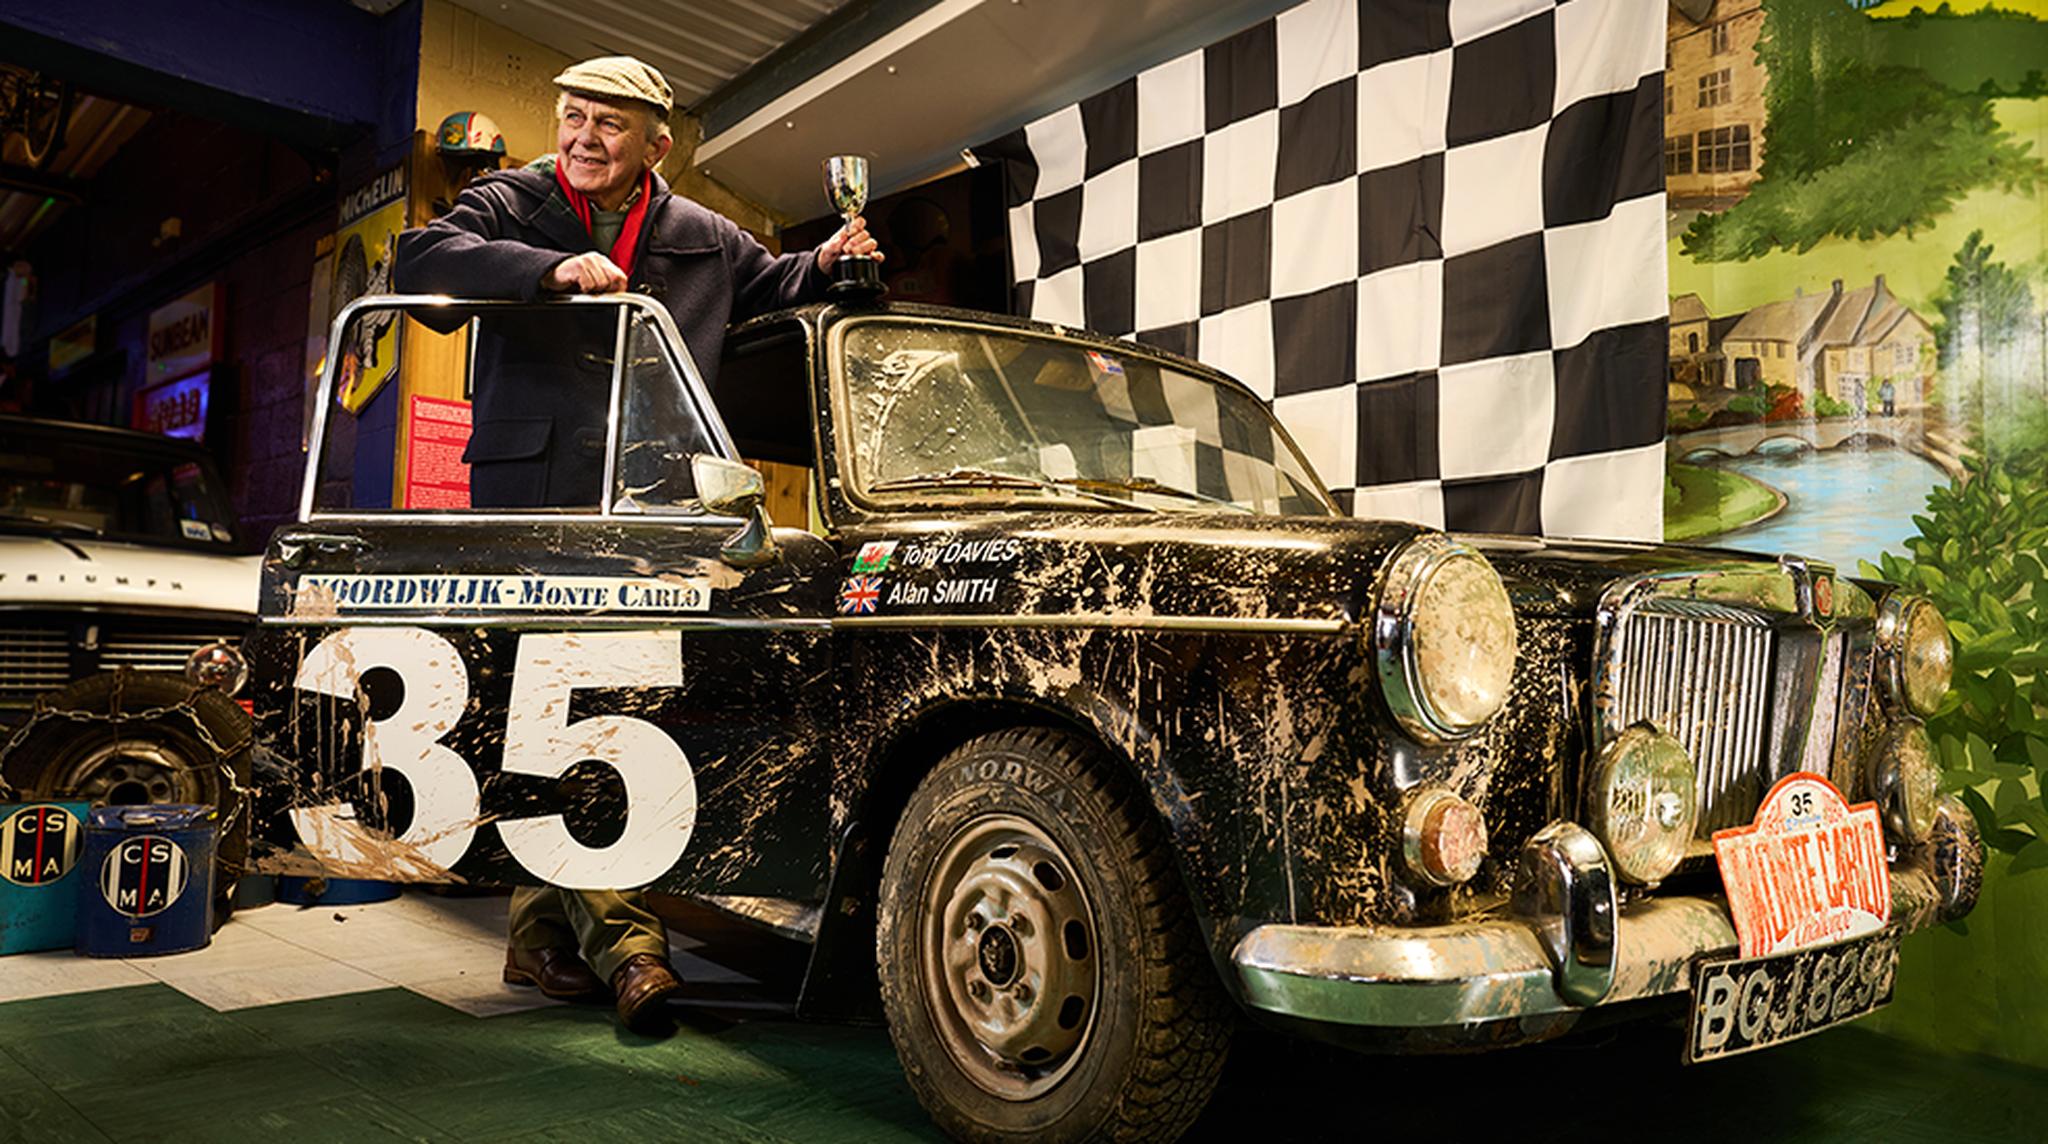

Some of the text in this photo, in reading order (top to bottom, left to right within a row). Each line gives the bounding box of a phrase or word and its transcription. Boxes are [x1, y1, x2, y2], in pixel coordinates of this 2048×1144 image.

[151, 308, 210, 362] SUNBEAM
[902, 539, 1021, 570] Tony DAVIES
[887, 578, 999, 605] Alan SMITH
[289, 626, 698, 890] 35
[1790, 792, 1814, 817] 35
